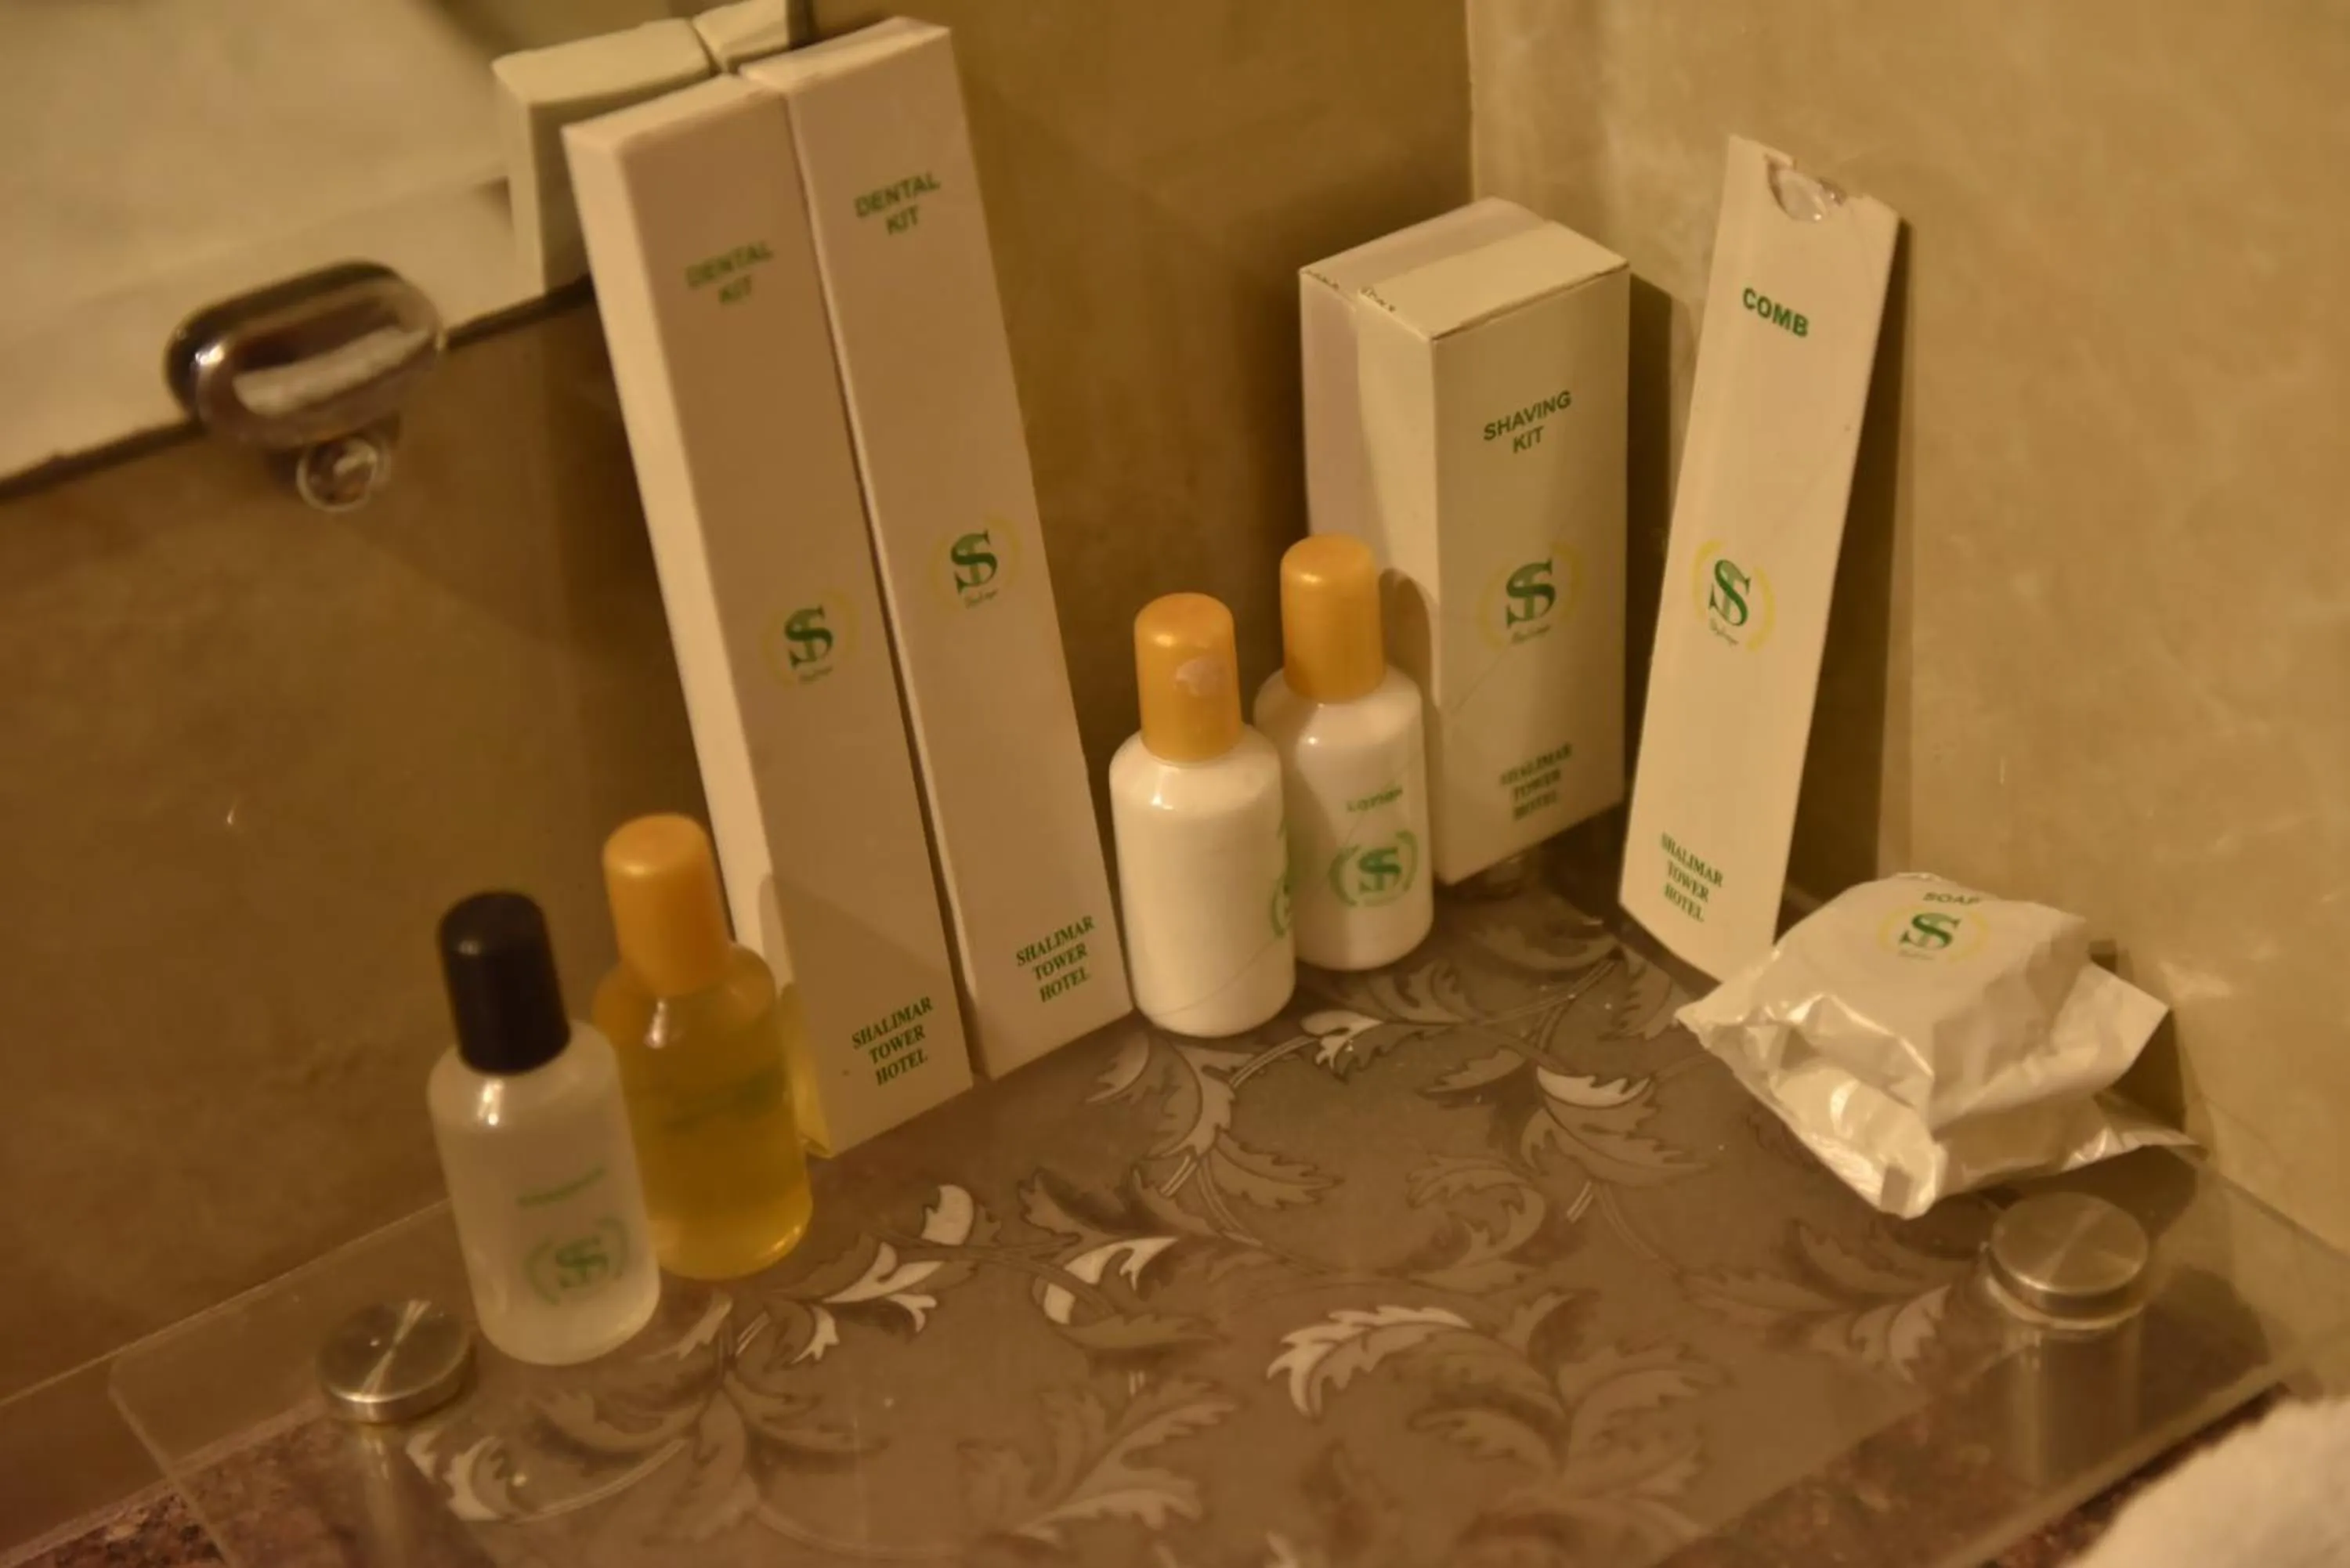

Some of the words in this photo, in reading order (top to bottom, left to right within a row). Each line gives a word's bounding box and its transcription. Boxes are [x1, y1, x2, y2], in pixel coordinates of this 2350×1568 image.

[854, 172, 941, 218] DENTAL
[886, 204, 920, 235] KIT
[685, 241, 774, 290] DENTAL
[1742, 287, 1810, 338] COMB
[1483, 389, 1572, 441] SHAVING
[1512, 425, 1544, 453] KIT
[1661, 831, 1723, 887] SHALIMAR
[1666, 859, 1709, 903] TOWER
[1922, 891, 1981, 906] SOAP
[1664, 882, 1705, 923] HOTEL
[1015, 916, 1095, 967] SHALIMAR
[1032, 942, 1087, 981] TOWER
[1039, 966, 1090, 1003] HOTEL
[851, 996, 933, 1050] SHALIMAR
[868, 1024, 926, 1064] TOWER
[875, 1050, 928, 1086] HOTEL
